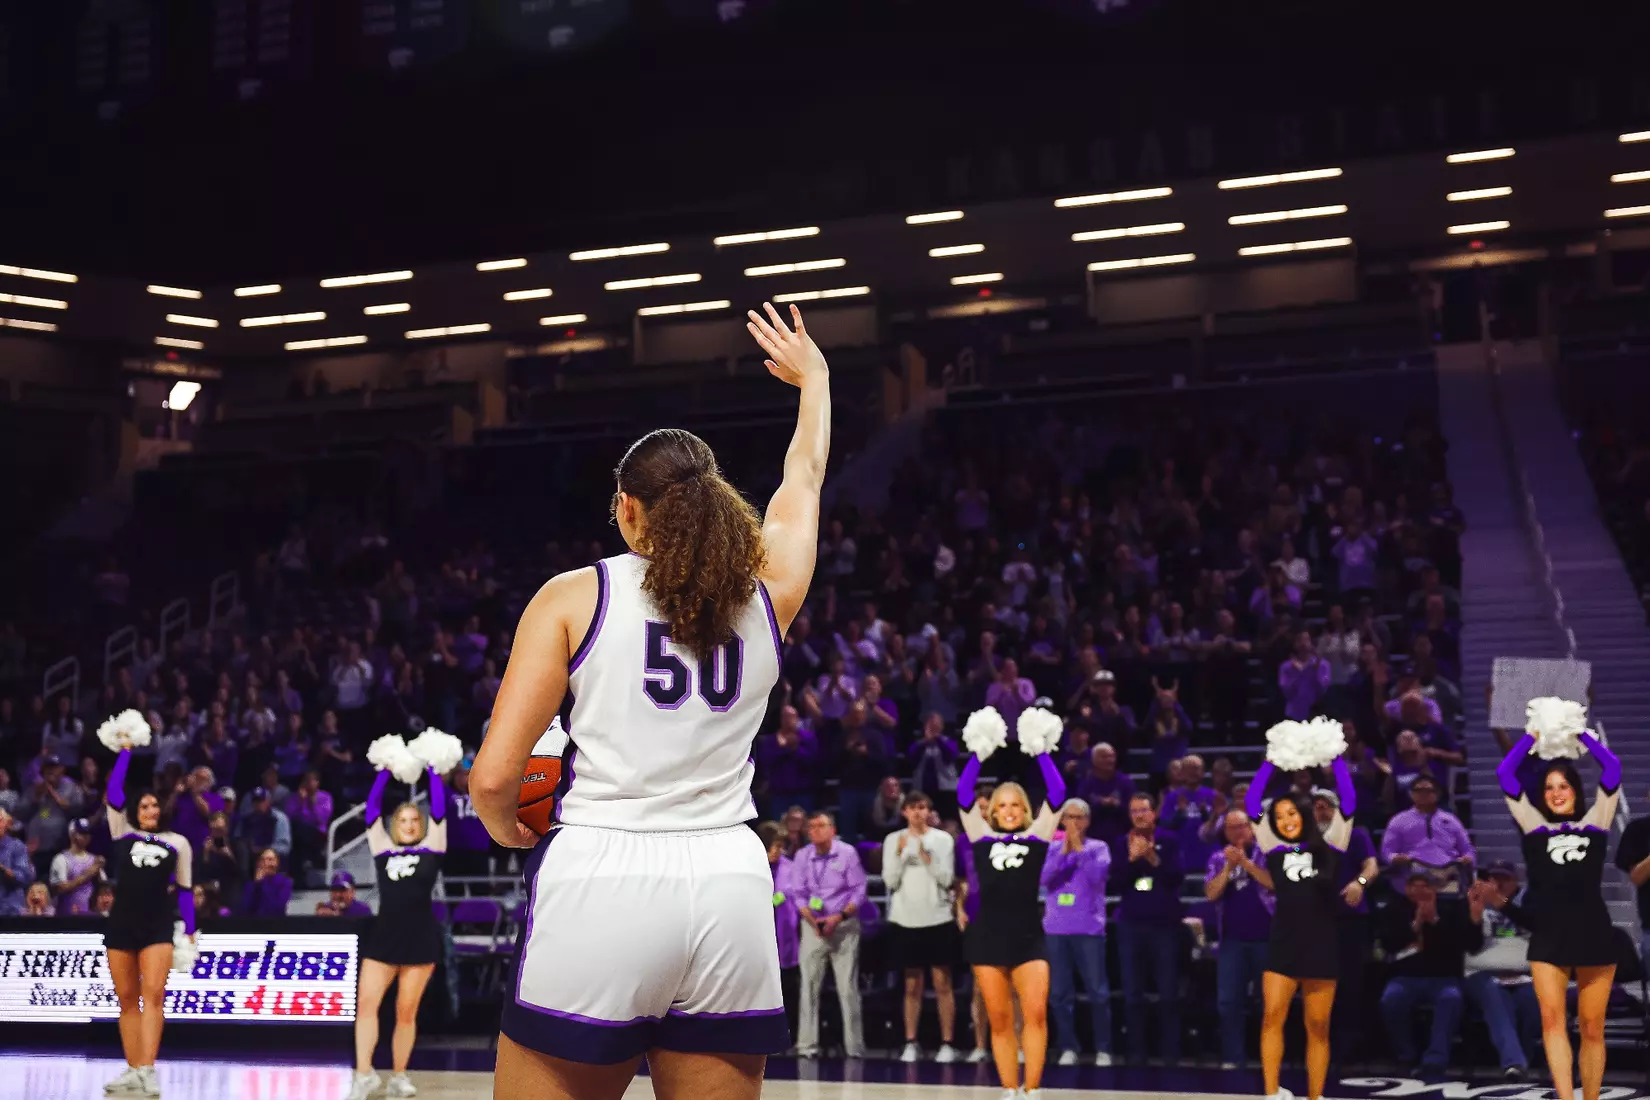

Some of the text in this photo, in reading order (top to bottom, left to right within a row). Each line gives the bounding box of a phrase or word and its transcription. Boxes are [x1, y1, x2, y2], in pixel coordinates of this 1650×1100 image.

[643, 619, 744, 712] 50
[521, 771, 546, 784] TEA
[18, 950, 104, 978] SERVICE
[191, 940, 350, 980] eerless
